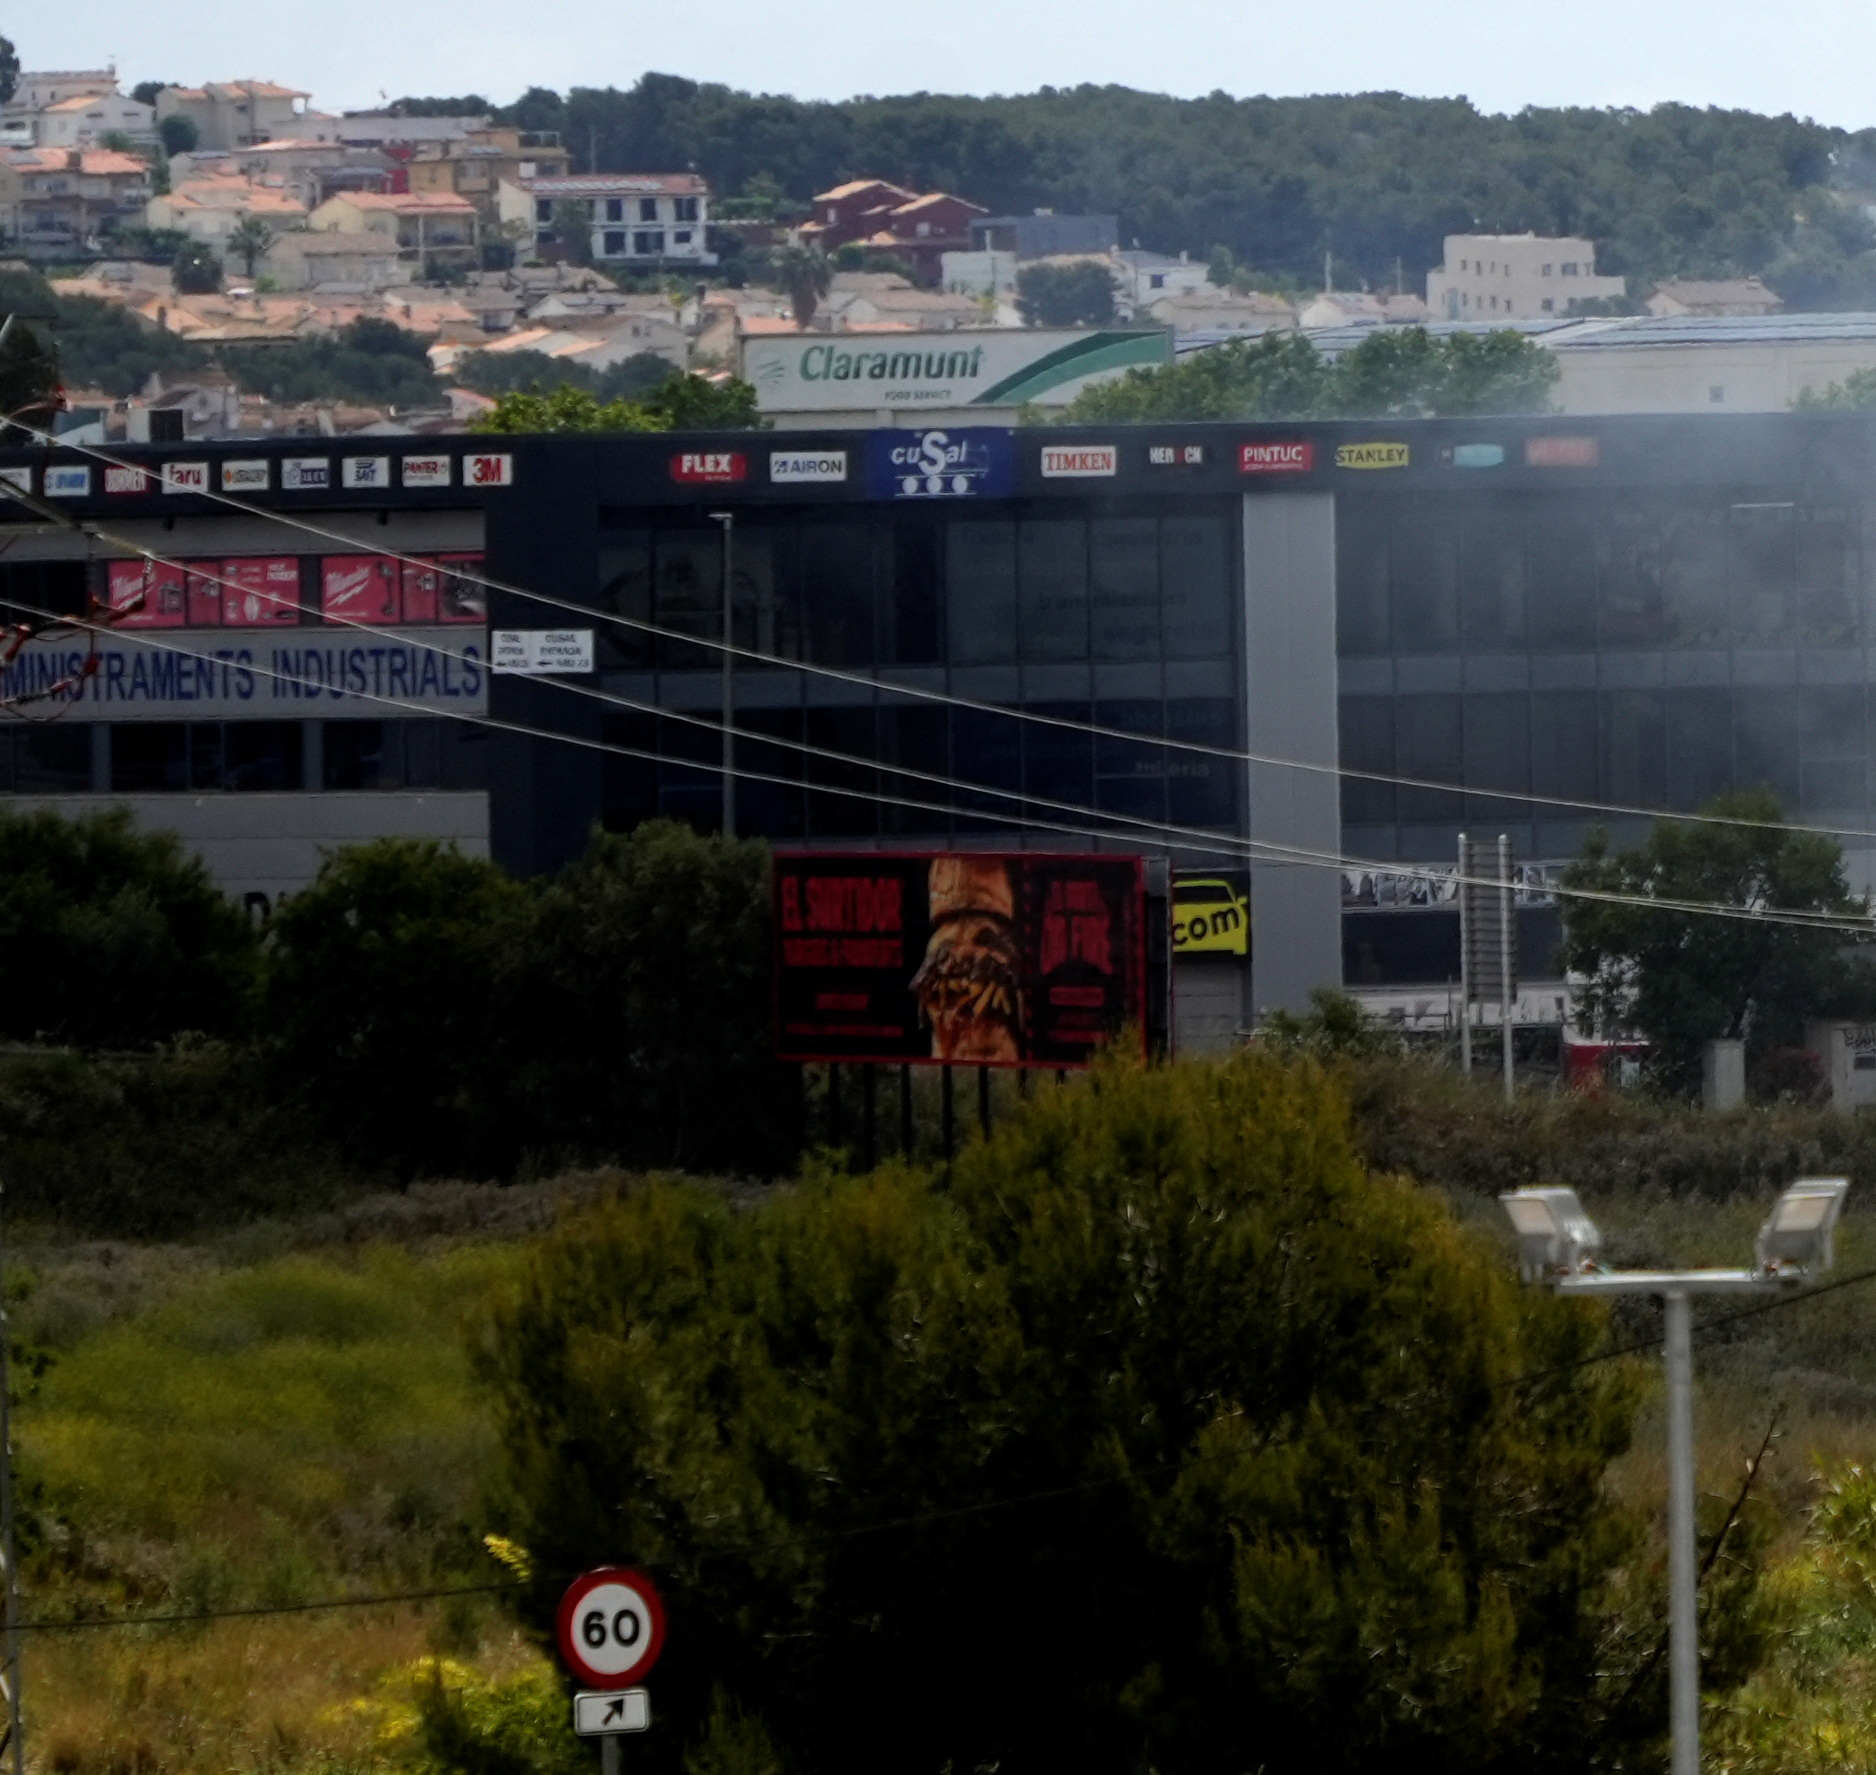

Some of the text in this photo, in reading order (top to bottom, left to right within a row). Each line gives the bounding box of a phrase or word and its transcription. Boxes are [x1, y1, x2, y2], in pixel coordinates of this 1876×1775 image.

[801, 345, 983, 381] Claramunt
[681, 453, 731, 473] FLEX
[1043, 452, 1112, 473] TIMKEN
[1243, 445, 1304, 463] PINTUC
[1335, 447, 1407, 464] STANLEY
[473, 457, 503, 484] 3M
[789, 459, 843, 475] AIRON
[271, 646, 482, 700] INDUSTRIALS
[583, 1609, 640, 1649] 60
